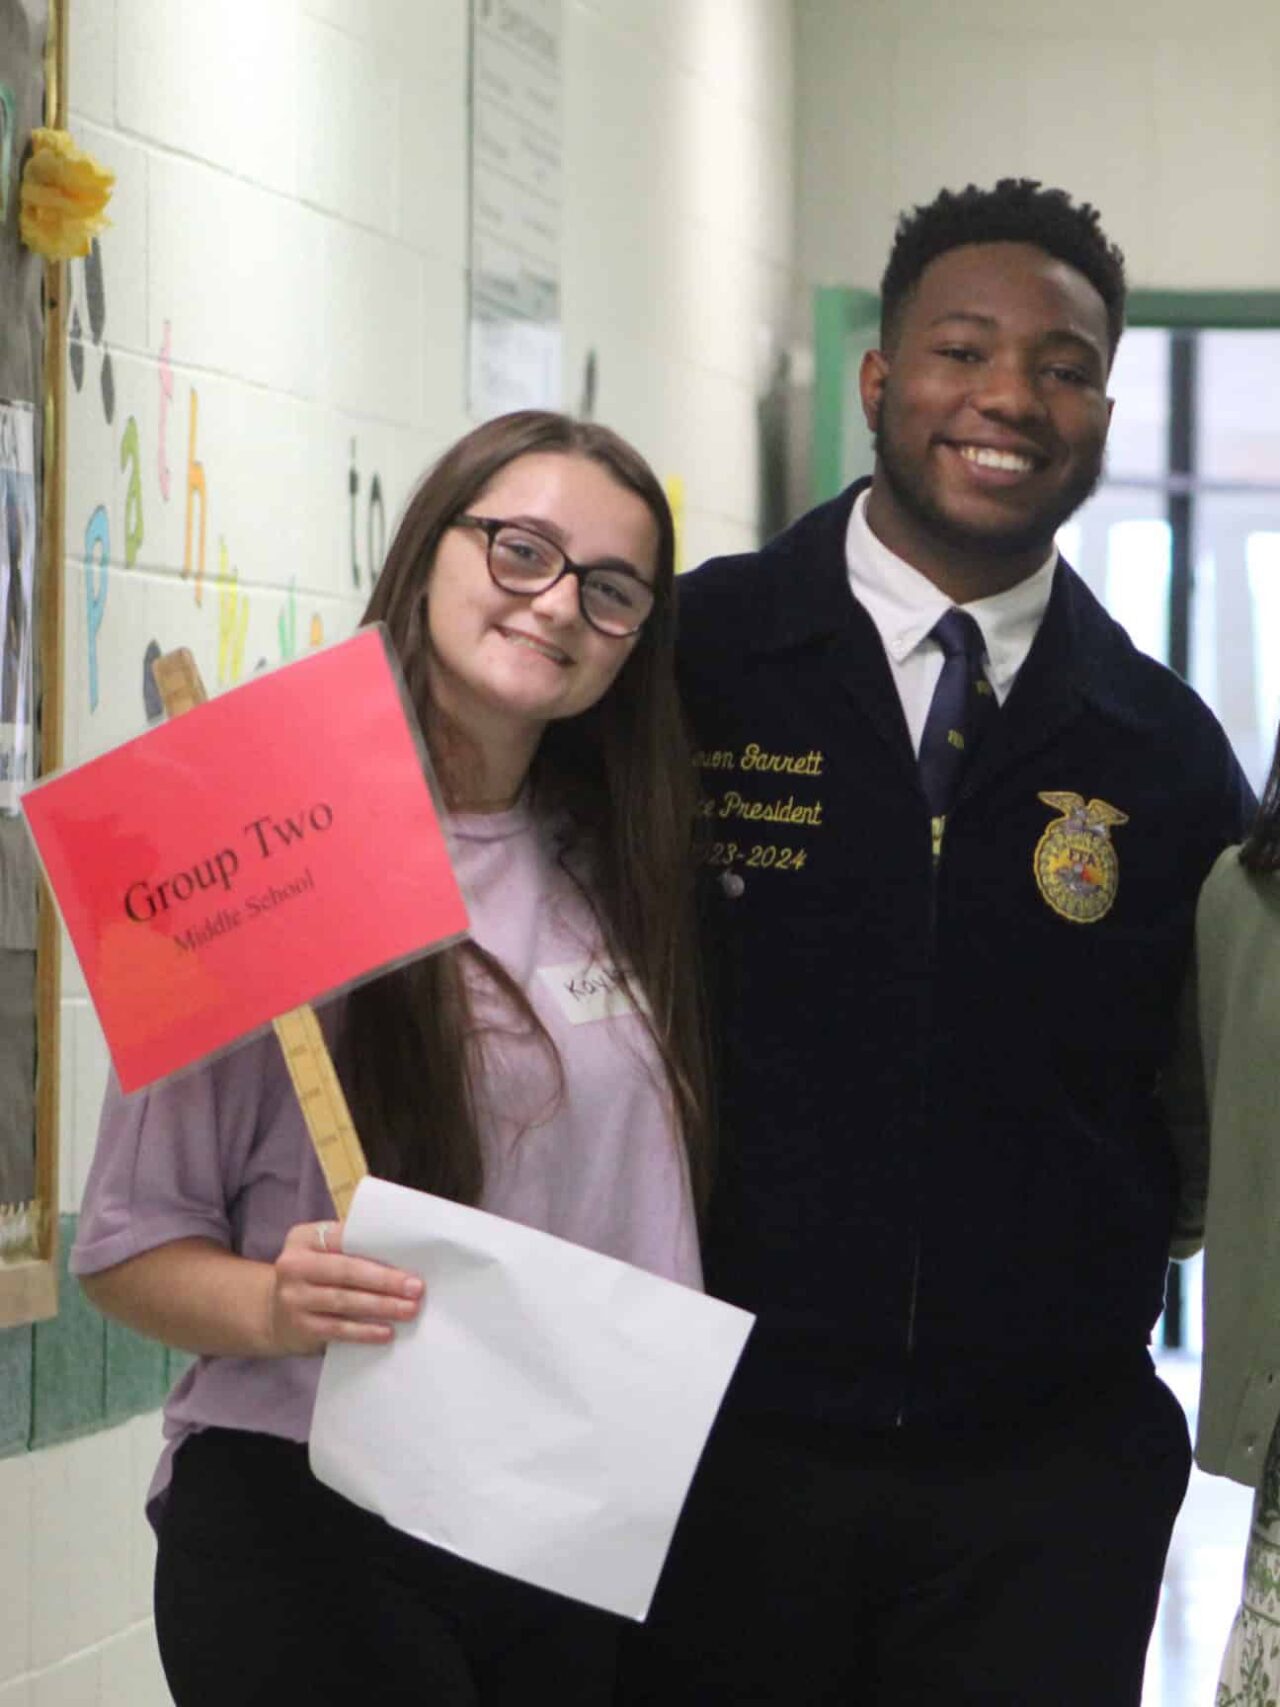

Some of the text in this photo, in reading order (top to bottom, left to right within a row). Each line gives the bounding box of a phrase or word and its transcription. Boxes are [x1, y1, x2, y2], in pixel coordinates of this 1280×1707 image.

[740, 743, 823, 775] Garrett
[719, 791, 822, 825] President
[123, 802, 333, 923] Group Two
[173, 867, 315, 954] Middle School
